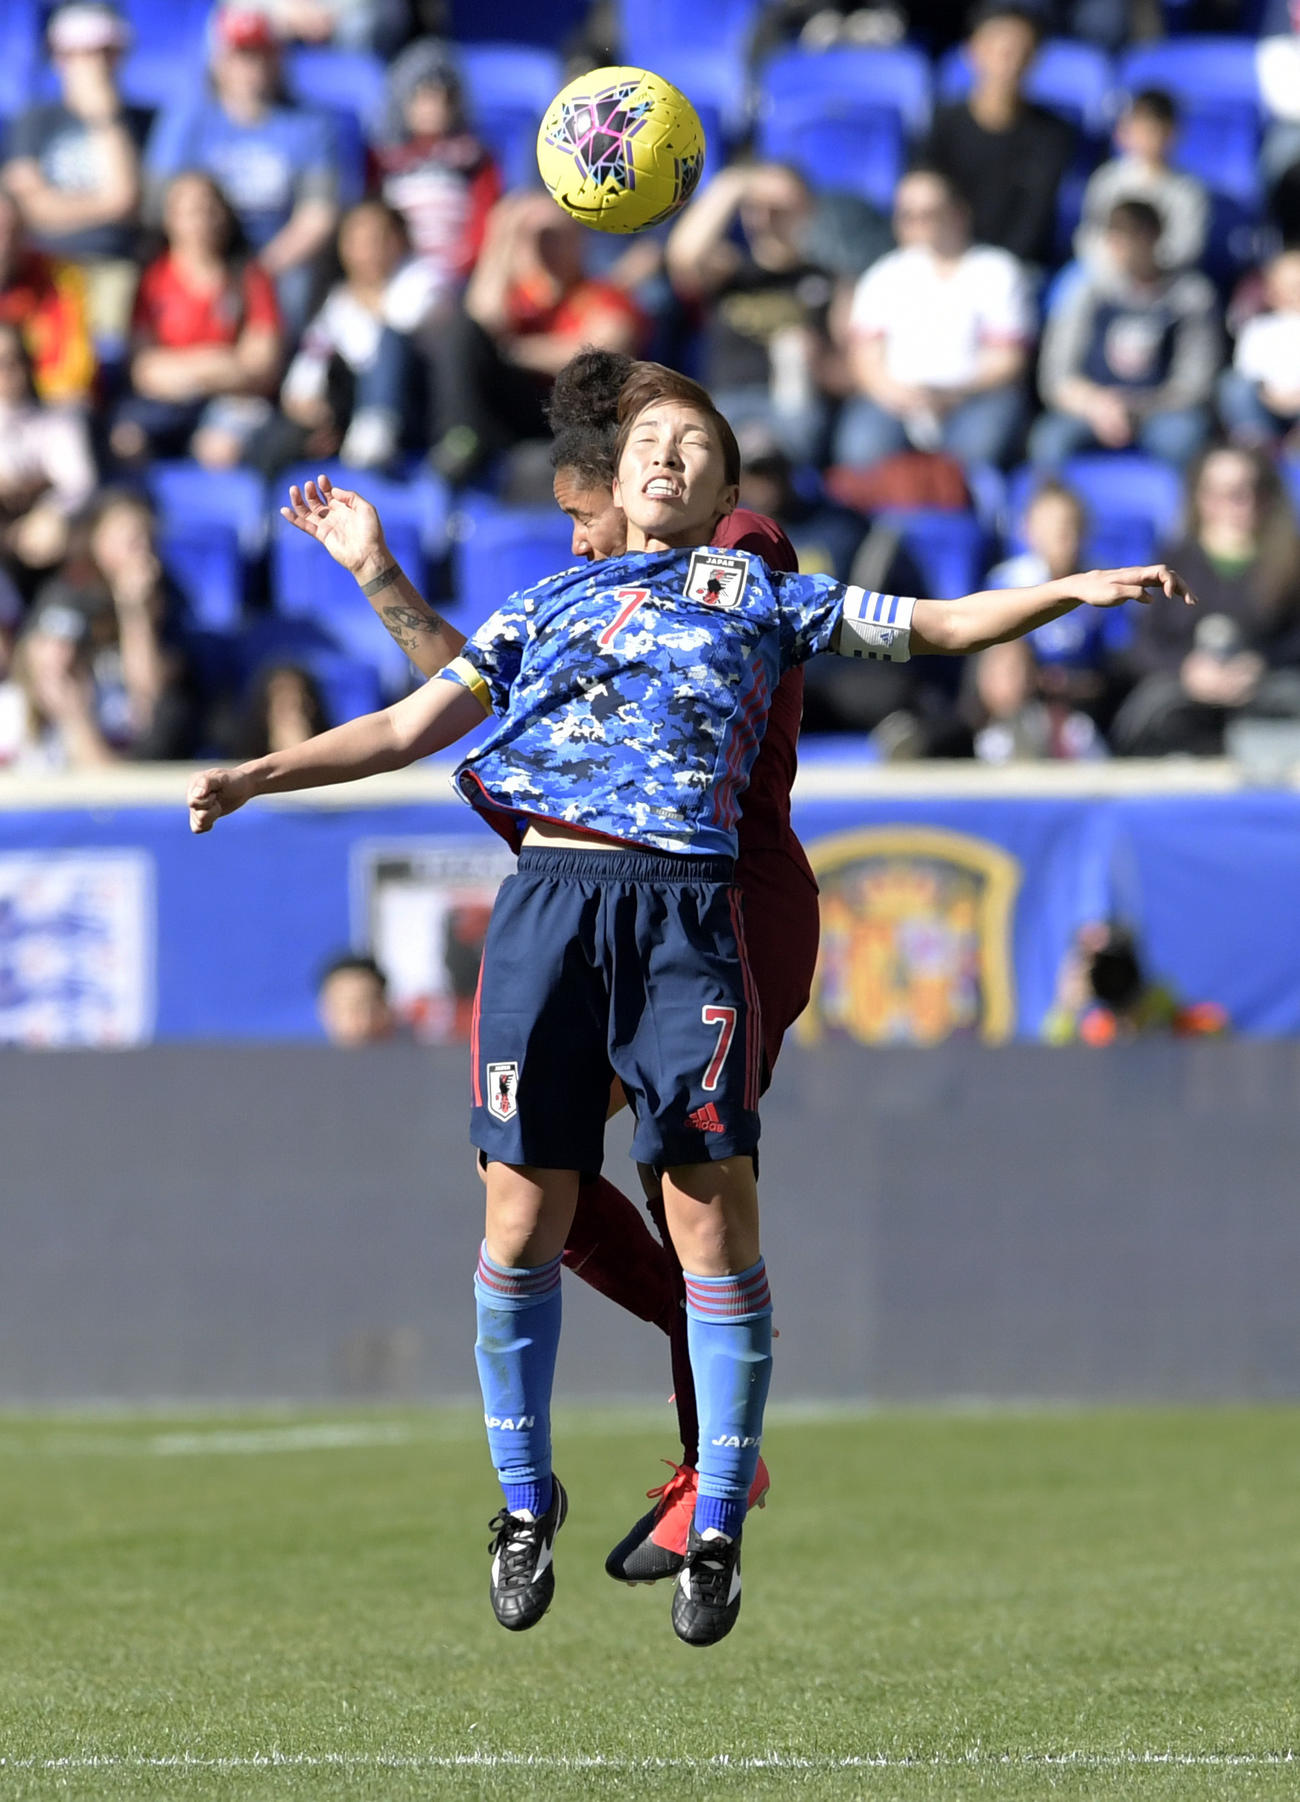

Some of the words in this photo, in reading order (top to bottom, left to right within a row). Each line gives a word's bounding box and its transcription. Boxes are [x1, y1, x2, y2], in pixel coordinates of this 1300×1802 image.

[705, 557, 735, 567] JAPAN
[598, 588, 651, 647] 7
[702, 1005, 737, 1091] 7
